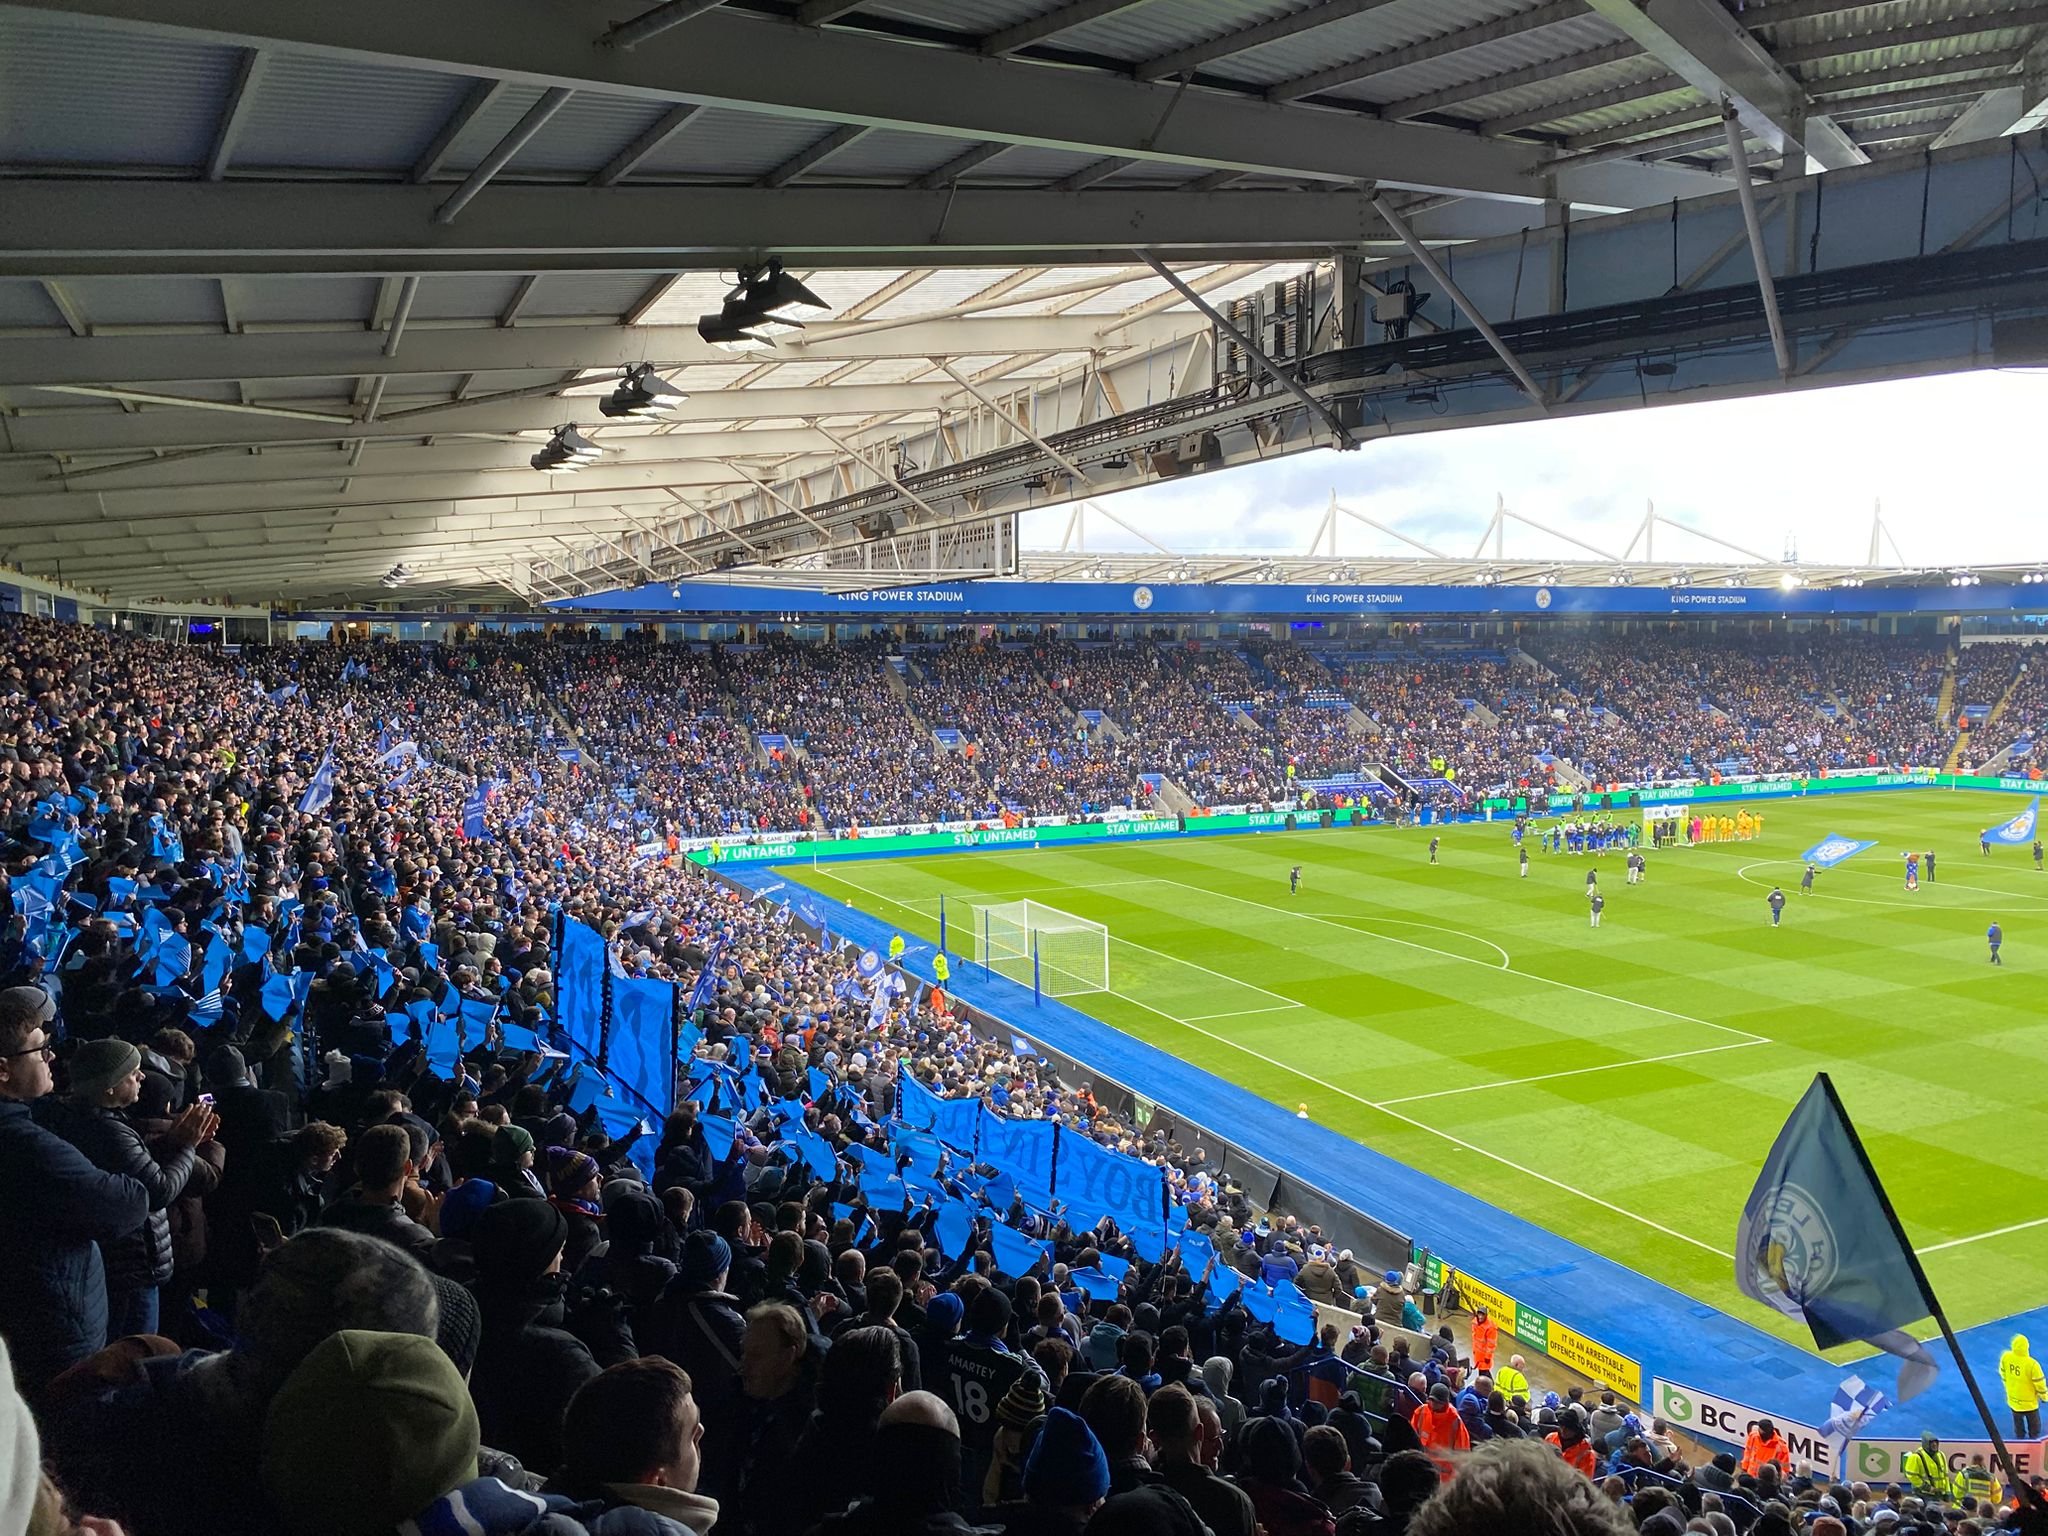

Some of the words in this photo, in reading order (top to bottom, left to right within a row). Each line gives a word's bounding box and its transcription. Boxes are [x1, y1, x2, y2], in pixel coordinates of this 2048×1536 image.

[838, 591, 869, 601] KING
[872, 591, 914, 601] POWER
[917, 591, 964, 602] STADIUM
[1306, 593, 1330, 603] KING
[1332, 593, 1364, 603] POWER
[1366, 594, 1403, 603] STADIUM
[1671, 595, 1690, 604] KING
[1691, 595, 1716, 604] POWER
[1717, 595, 1747, 604] STADIUM
[1741, 784, 1759, 794] STAY
[1759, 782, 1793, 792] UNTAMED
[2000, 779, 2022, 790] STAY
[1640, 790, 1658, 800] STAY
[1658, 788, 1695, 799] UNTAMED
[1248, 815, 1271, 826] STAY
[983, 829, 1037, 844] UNTAMED
[1106, 823, 1131, 835] STAY
[707, 849, 730, 864] SY
[732, 845, 797, 859] UNTAMED
[1472, 1286, 1504, 1310] ARRESTABLE
[1498, 1312, 1514, 1327] POINT
[1521, 1310, 1532, 1321] LIFT
[1532, 1316, 1542, 1326] OFF
[1518, 1318, 1525, 1327] IN
[1524, 1321, 1537, 1333] CASE
[1538, 1328, 1545, 1336] OF
[1517, 1326, 1546, 1347] EMERGENCY
[1561, 1334, 1567, 1342] IT
[1568, 1337, 1575, 1347] IS
[1576, 1342, 1585, 1352] AN
[1585, 1346, 1625, 1373] ARRESTABLE
[948, 1354, 997, 1379] AMARTEY
[1550, 1340, 1576, 1361] OFFENCE
[1577, 1355, 1586, 1366] TO
[1586, 1359, 1601, 1374] PASS
[1602, 1368, 1616, 1382] THIS
[1617, 1376, 1637, 1393] POINT
[2009, 1363, 2021, 1376] P6
[951, 1372, 990, 1424] 18
[1701, 1403, 1829, 1465] BC.ME
